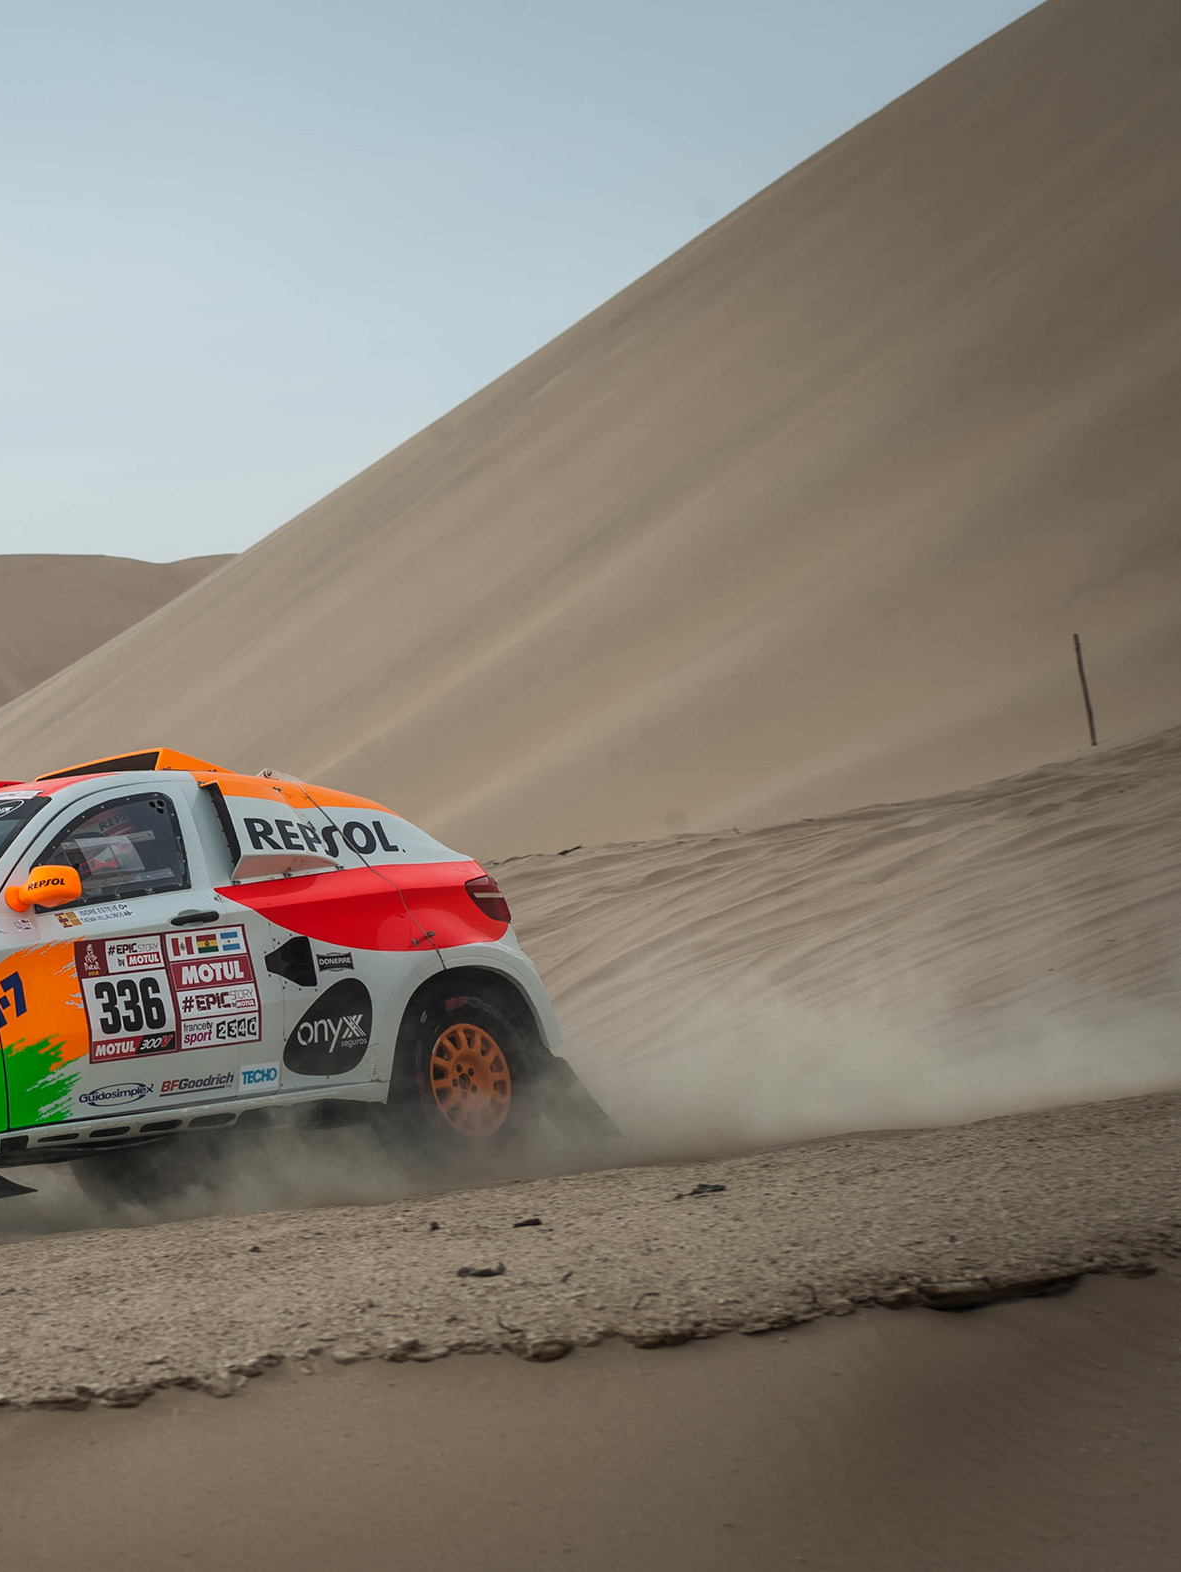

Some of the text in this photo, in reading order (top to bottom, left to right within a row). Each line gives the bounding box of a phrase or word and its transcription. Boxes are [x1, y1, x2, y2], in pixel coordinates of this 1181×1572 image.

[243, 818, 400, 858] REPSOL
[27, 878, 66, 891] REPSOL
[129, 953, 160, 965] MOTUL
[319, 956, 352, 966] DONERRE
[181, 961, 244, 985] MOTUL
[94, 977, 167, 1034] 336
[95, 1035, 174, 1057] MOTUL 300V
[183, 1029, 213, 1045] sport
[341, 1037, 368, 1048] seguros
[160, 1072, 234, 1094] BFGoodrich
[241, 1067, 278, 1085] TECHO
[78, 1083, 155, 1104] Guidosimplex
